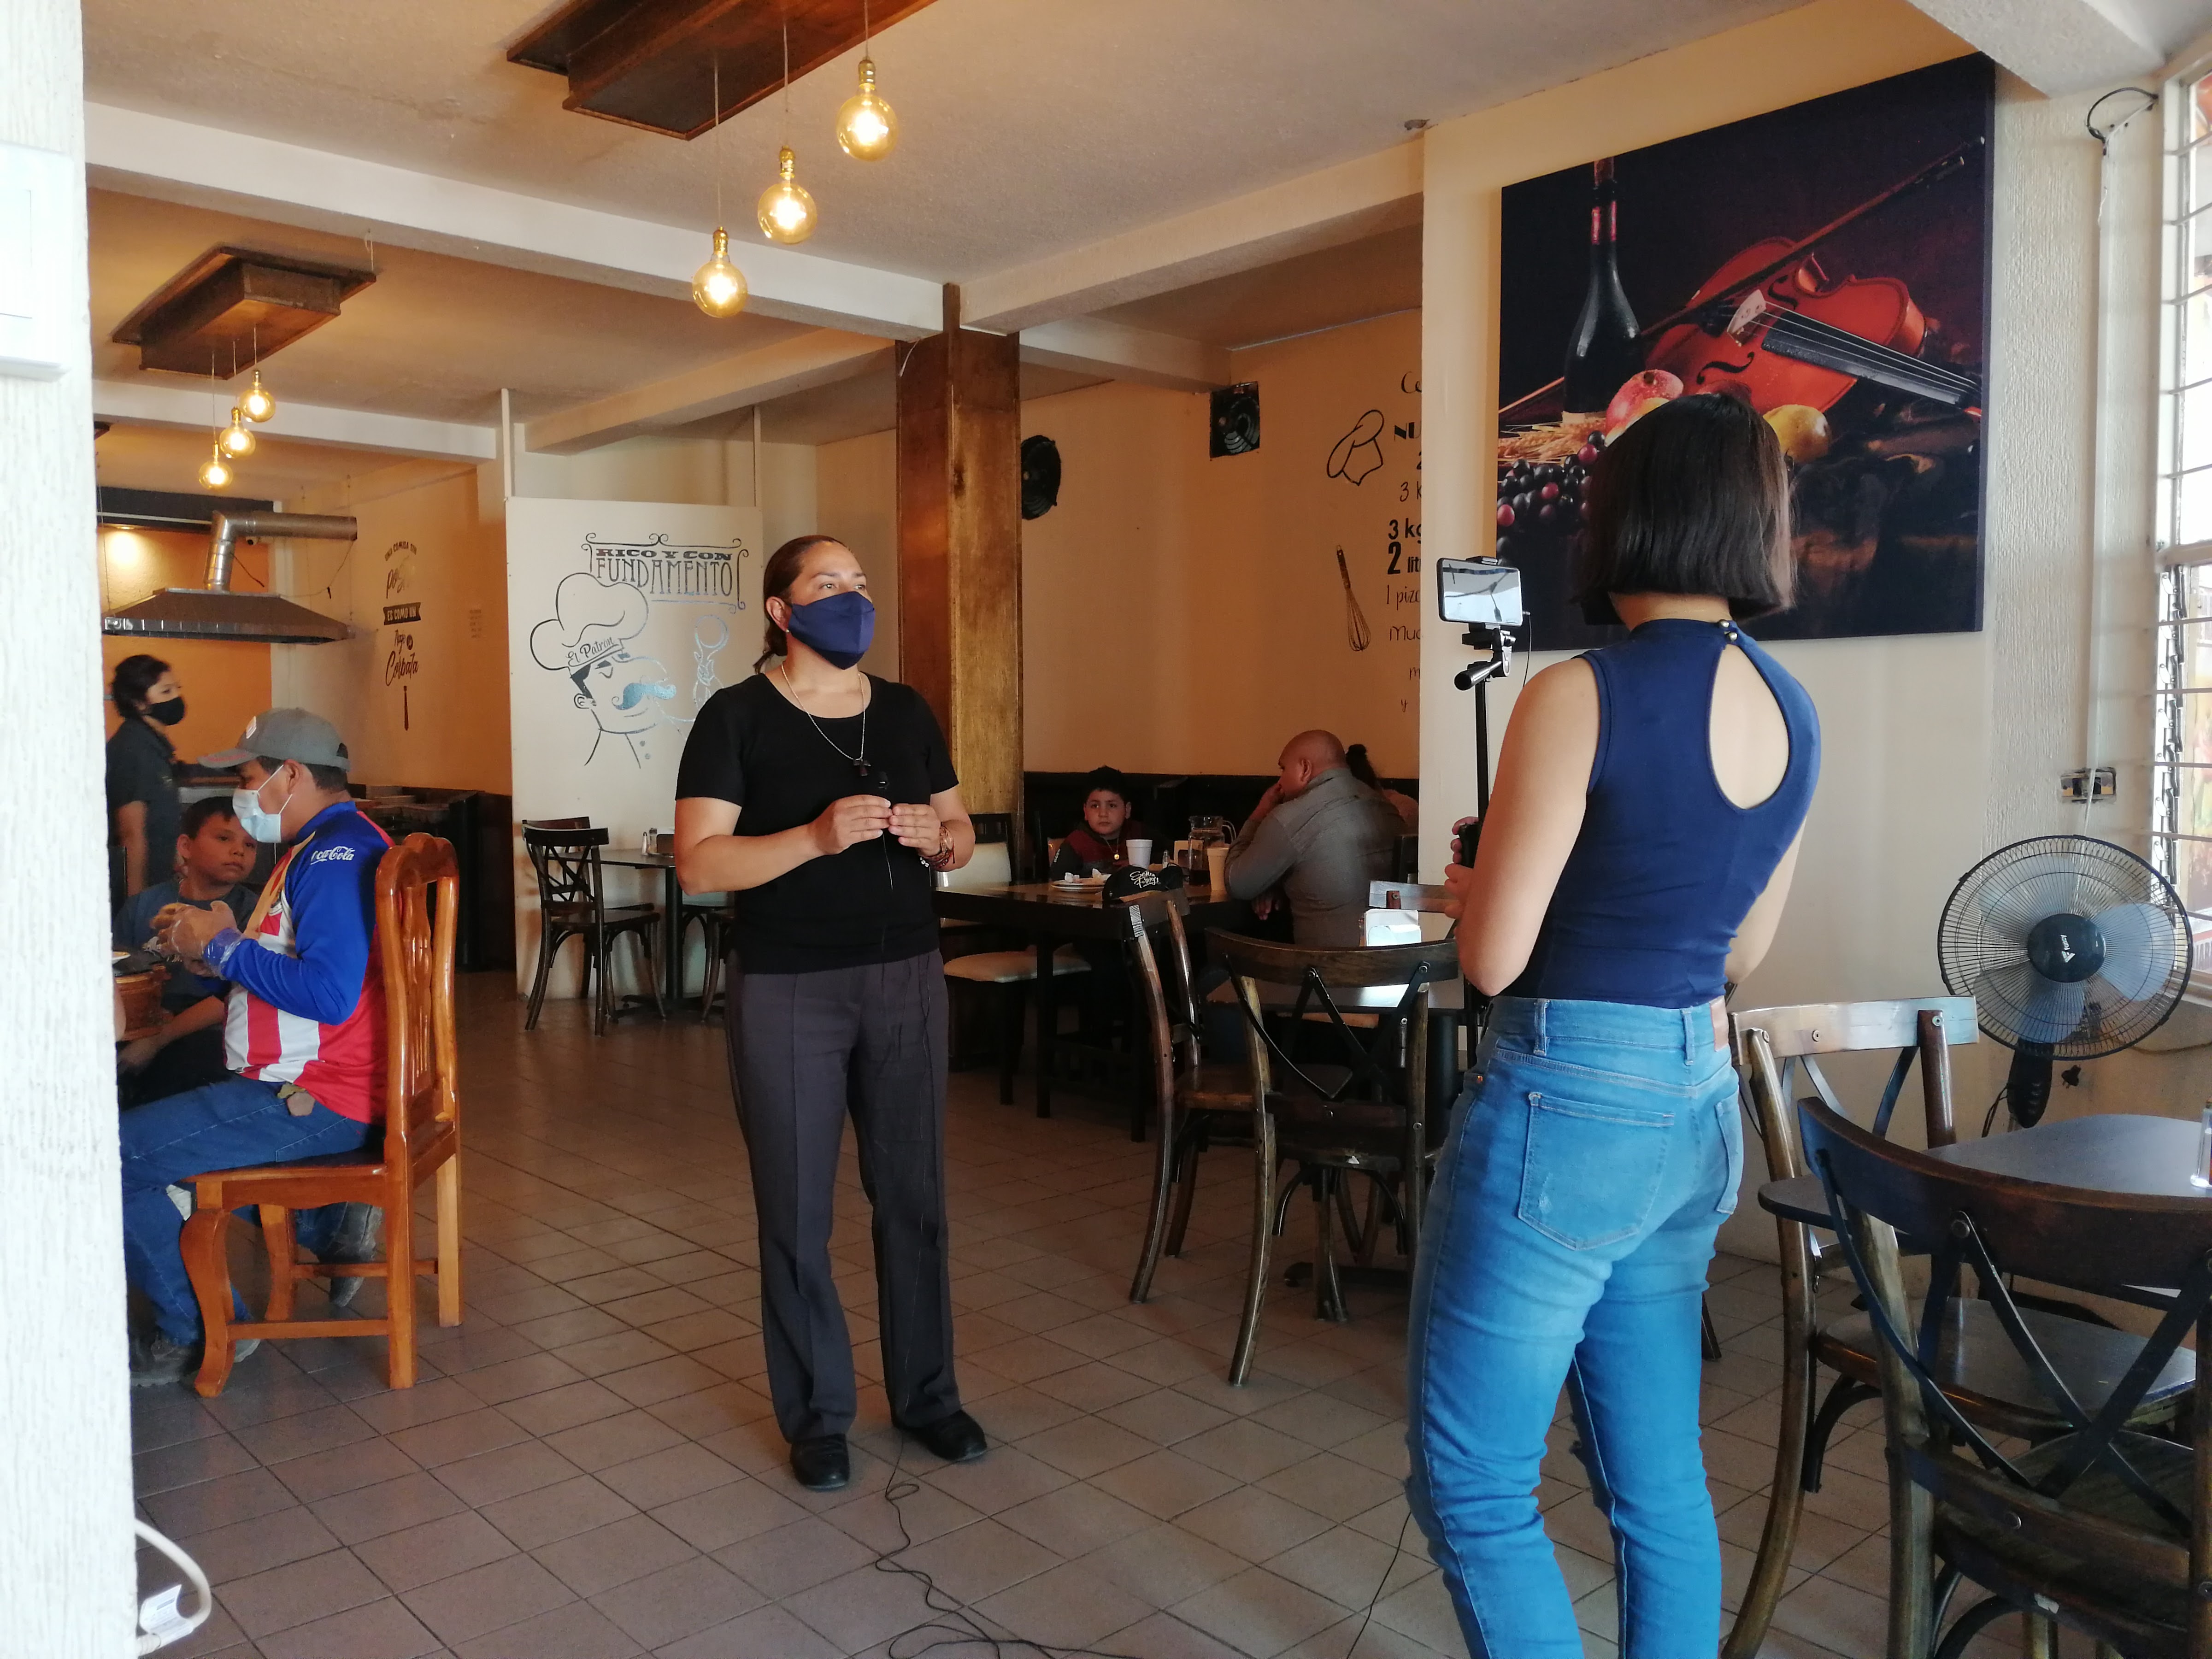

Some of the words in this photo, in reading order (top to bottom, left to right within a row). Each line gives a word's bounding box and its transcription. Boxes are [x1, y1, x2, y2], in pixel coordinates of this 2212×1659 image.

[1400, 482, 1409, 502] 3
[1388, 519, 1398, 540] 3
[596, 548, 657, 558] RICO
[683, 551, 733, 560] CON
[1388, 541, 1401, 574] 2
[1407, 556, 1421, 573] lit
[596, 558, 733, 597] FUNDAMENTO
[388, 610, 393, 621] ES
[394, 607, 408, 620] COMO
[409, 606, 416, 618] UN
[385, 651, 419, 686] Corbata
[565, 651, 580, 667] El
[1401, 699, 1407, 712] y
[310, 846, 355, 865] ca-Cola
